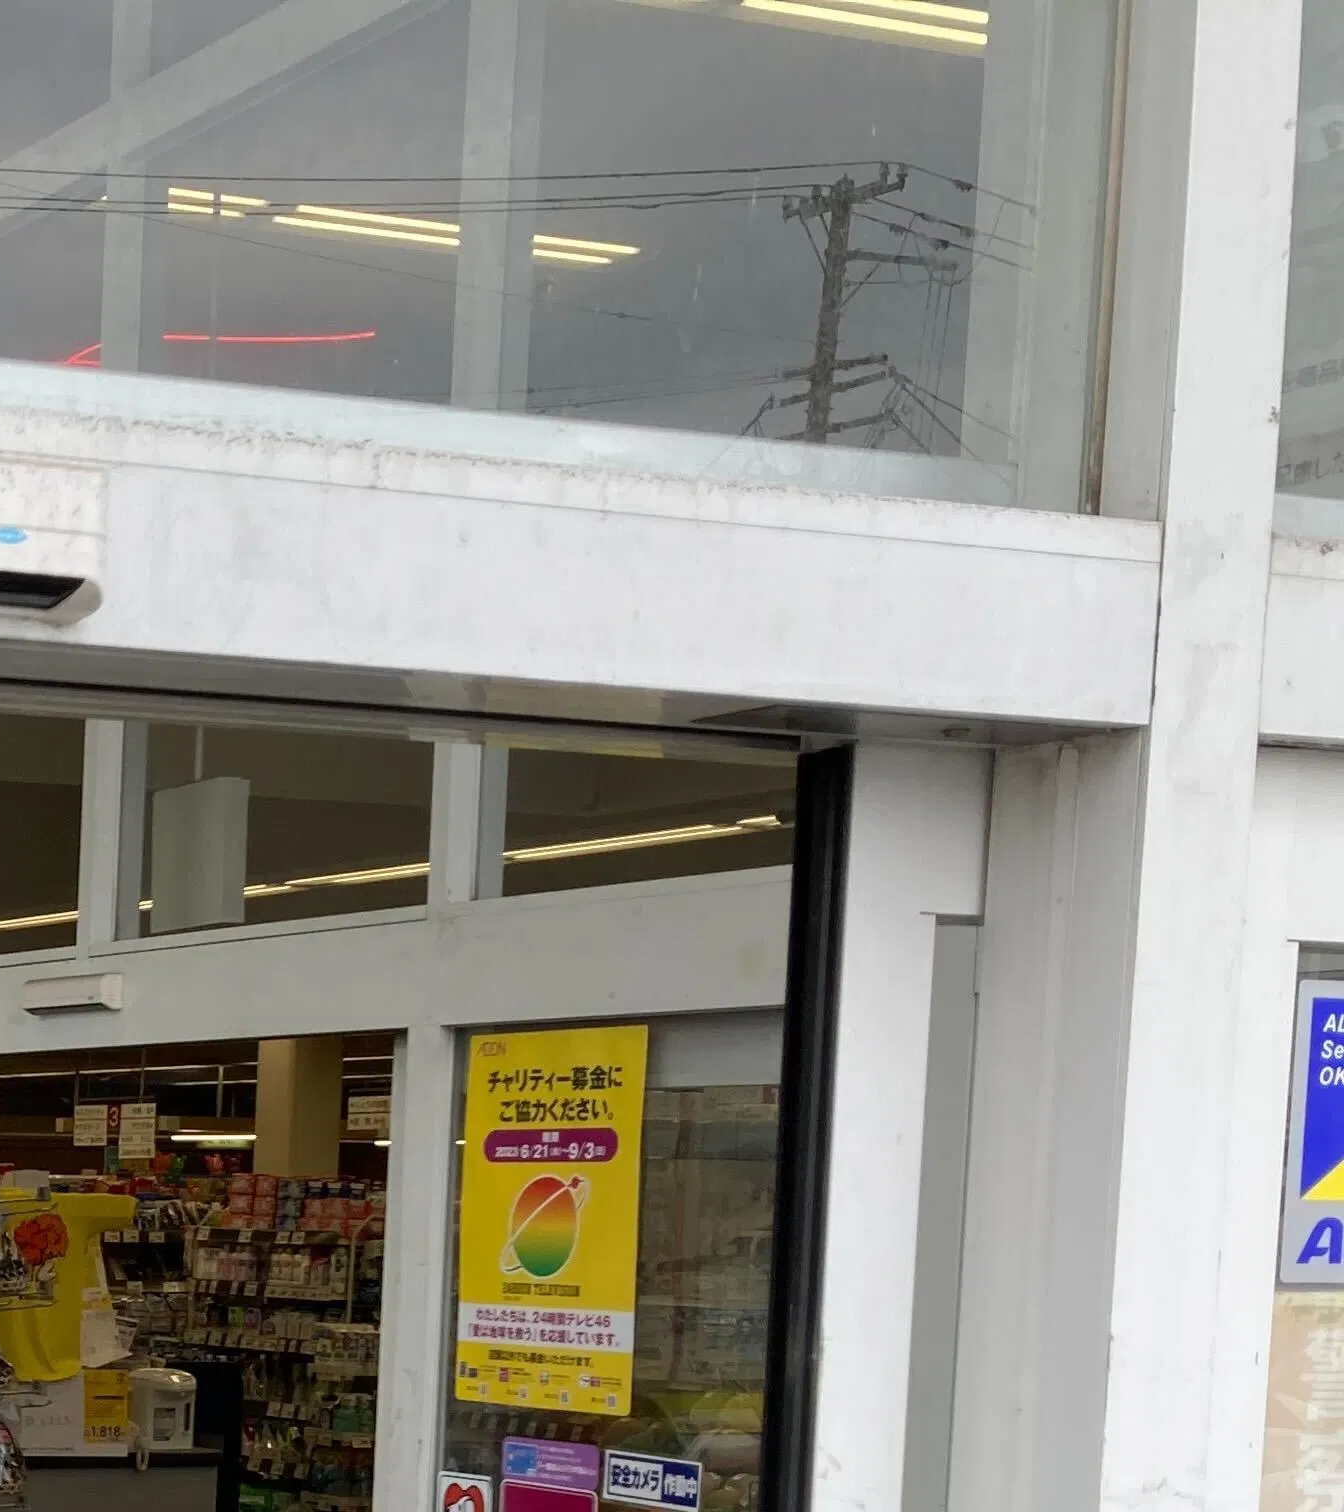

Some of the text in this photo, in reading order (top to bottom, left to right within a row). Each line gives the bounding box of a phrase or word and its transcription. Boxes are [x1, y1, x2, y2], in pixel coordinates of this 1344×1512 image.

[487, 1066, 623, 1093] チャリティー募金に
[498, 1098, 614, 1123] ご協力ください。
